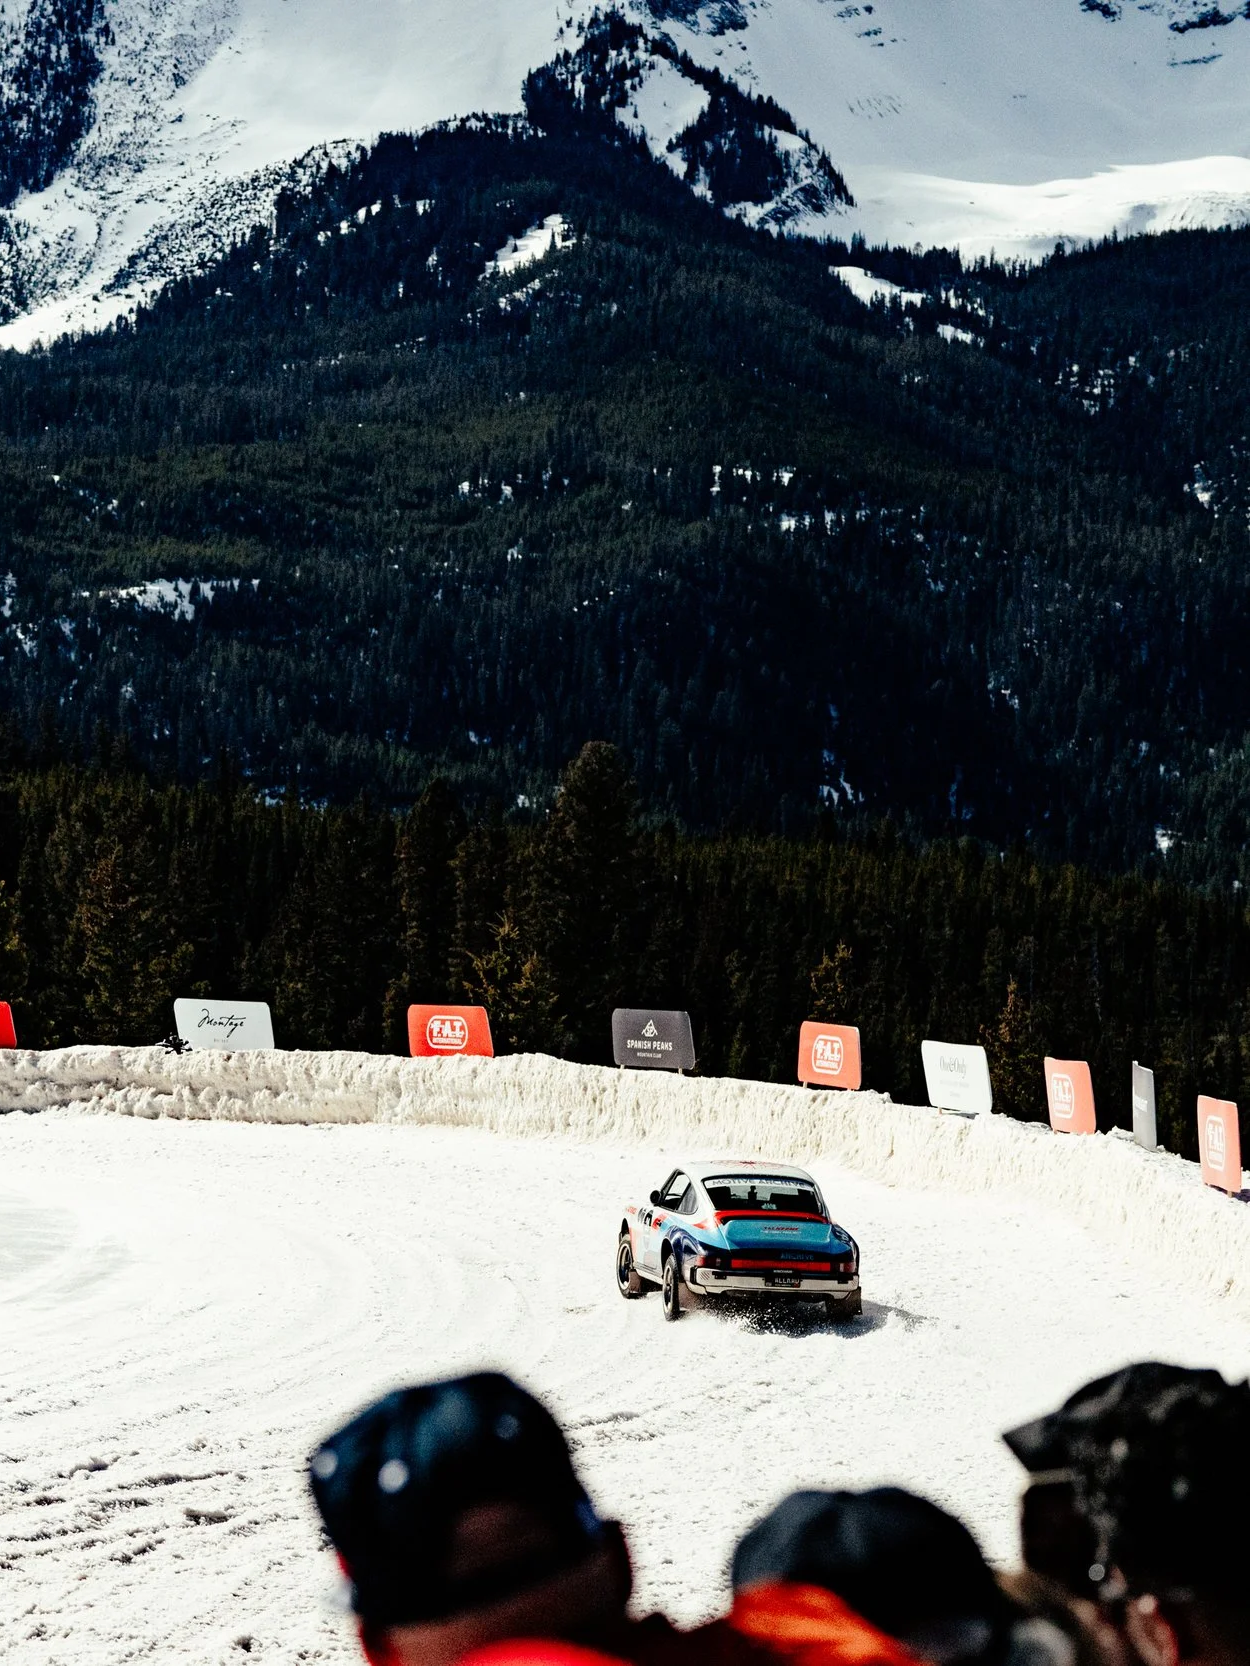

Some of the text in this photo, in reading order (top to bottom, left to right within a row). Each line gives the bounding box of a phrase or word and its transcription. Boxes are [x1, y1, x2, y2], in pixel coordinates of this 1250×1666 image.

[198, 1008, 247, 1038] Montage
[627, 1039, 673, 1051] SPANISH PEAKS
[712, 1178, 756, 1186] MOTIVE
